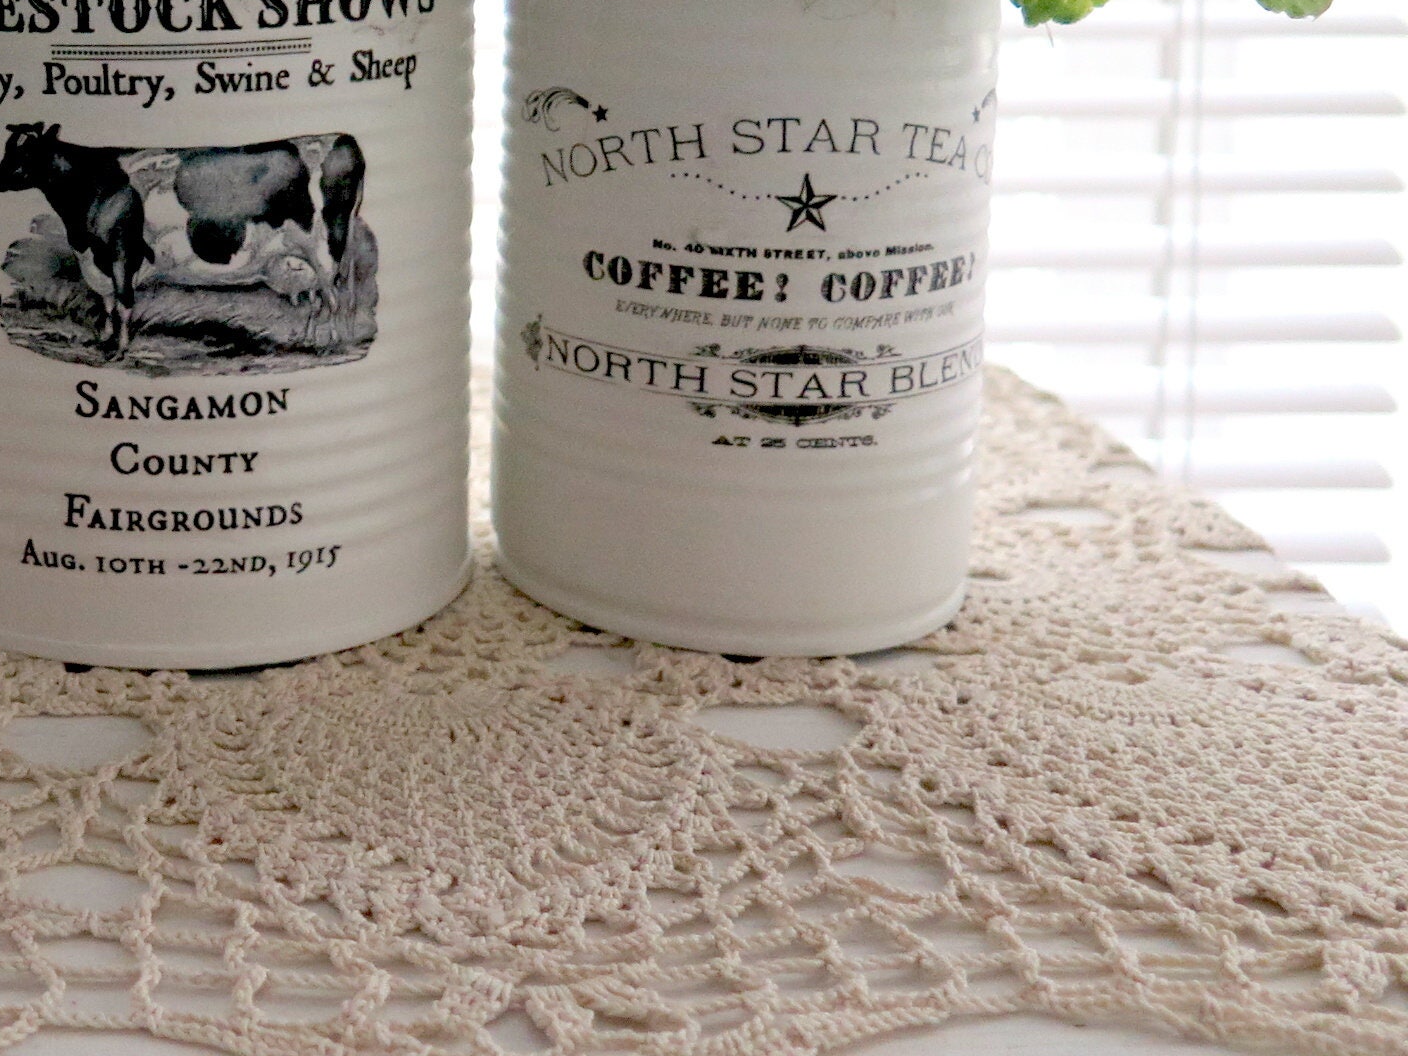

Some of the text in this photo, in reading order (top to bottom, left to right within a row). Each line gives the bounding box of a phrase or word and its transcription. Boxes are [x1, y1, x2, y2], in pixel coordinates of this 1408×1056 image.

[44, 61, 175, 108] Poultry,
[195, 61, 290, 95] Swine
[309, 59, 335, 84] &
[350, 50, 418, 90] Sheep
[540, 122, 706, 187] NORTH
[732, 118, 881, 155] STAR
[902, 123, 965, 171] TEA
[652, 238, 677, 252] No.
[764, 249, 831, 261] STREET,
[583, 249, 976, 303] COFFEE! COFFEE!
[720, 313, 754, 328] BUT
[546, 333, 709, 393] NORTH
[730, 368, 870, 398] STAR
[75, 381, 290, 420] SANGAMON
[712, 435, 750, 447] AT
[64, 493, 303, 532] FAIRGROUNDS
[286, 544, 342, 574] 1915
